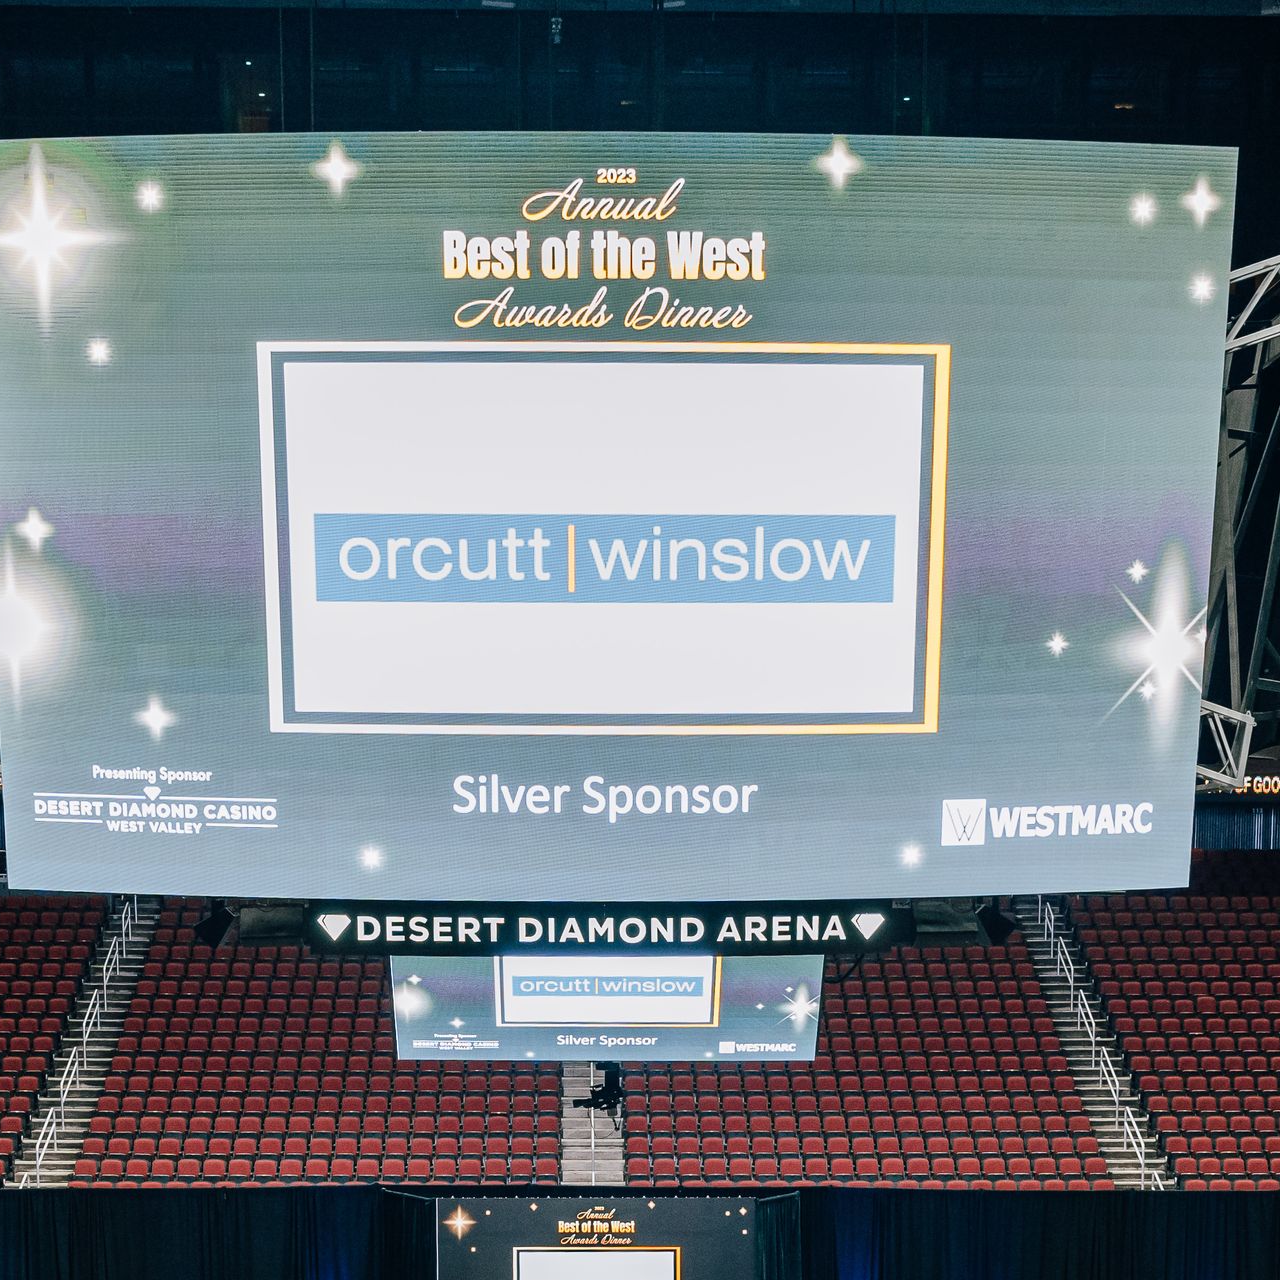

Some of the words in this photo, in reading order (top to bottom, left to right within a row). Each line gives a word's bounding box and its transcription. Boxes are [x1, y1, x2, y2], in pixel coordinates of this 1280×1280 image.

[597, 168, 637, 184] 2023
[521, 177, 686, 221] Annual
[443, 230, 531, 280] Best
[541, 230, 582, 280] of
[590, 230, 657, 280] the
[667, 230, 766, 281] West
[454, 286, 614, 329] Awards
[624, 286, 753, 331] Dinner
[338, 527, 551, 583] orcutt
[589, 526, 871, 583] winslow
[92, 765, 156, 783] Presenting
[159, 767, 213, 785] Sponsor
[452, 775, 570, 815] Silver
[582, 775, 759, 823] Sponsor
[34, 799, 103, 816] DESERT
[109, 802, 198, 819] DIAMOND
[203, 804, 277, 822] CASINO
[990, 802, 1154, 839] WESTMARC
[106, 820, 146, 833] WEST
[149, 821, 203, 834] VALLEY
[357, 915, 504, 942] DESERT
[518, 915, 704, 944] DIAMOND
[717, 915, 847, 942] ARENA
[519, 977, 591, 993] orcutt
[603, 976, 696, 993] winslow
[556, 1034, 596, 1047] Silver
[599, 1034, 658, 1048] Sponsor
[735, 1043, 797, 1053] WESTMARC
[577, 1208, 616, 1220] Annual
[558, 1220, 579, 1233] Best
[581, 1221, 591, 1233] of
[593, 1220, 609, 1233] the
[611, 1220, 635, 1233] West
[561, 1234, 599, 1245] Awards
[601, 1234, 632, 1245] Dinner
